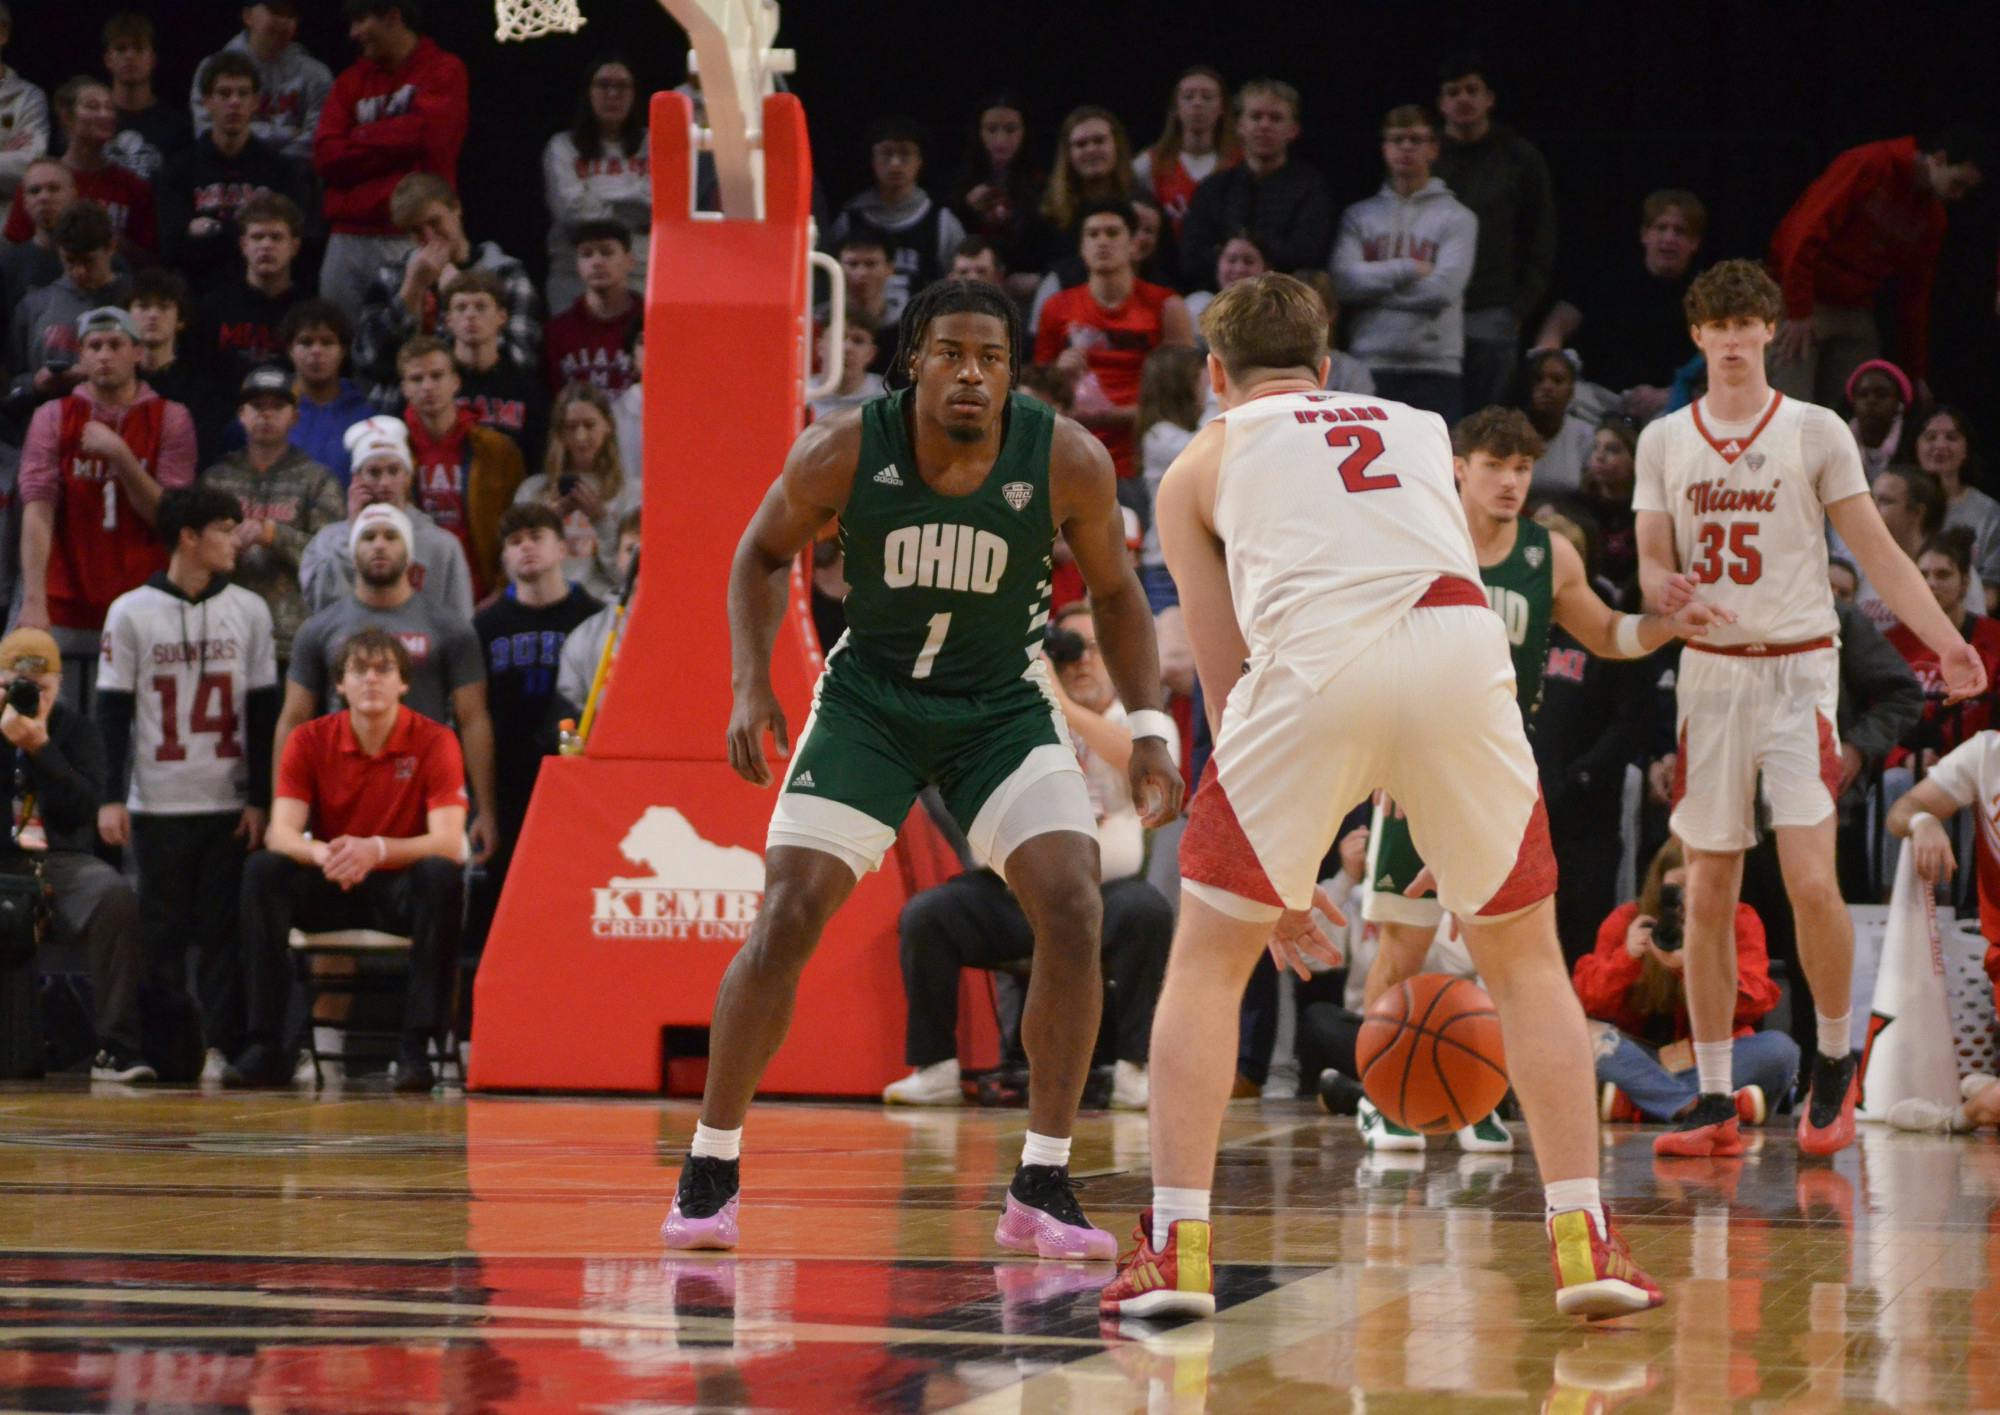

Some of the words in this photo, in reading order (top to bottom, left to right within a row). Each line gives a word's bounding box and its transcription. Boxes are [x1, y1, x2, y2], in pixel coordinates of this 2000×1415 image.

[1293, 406, 1389, 424] IPSARO
[872, 474, 904, 487] adidas
[1324, 424, 1402, 493] 2
[102, 479, 117, 529] 1
[1686, 477, 1782, 516] Miami
[883, 523, 1009, 594] OHIO
[1692, 521, 1763, 586] 35
[911, 612, 952, 679] 1
[152, 671, 243, 762] 14
[590, 887, 765, 922] KEMB
[591, 921, 690, 939] CREDIT
